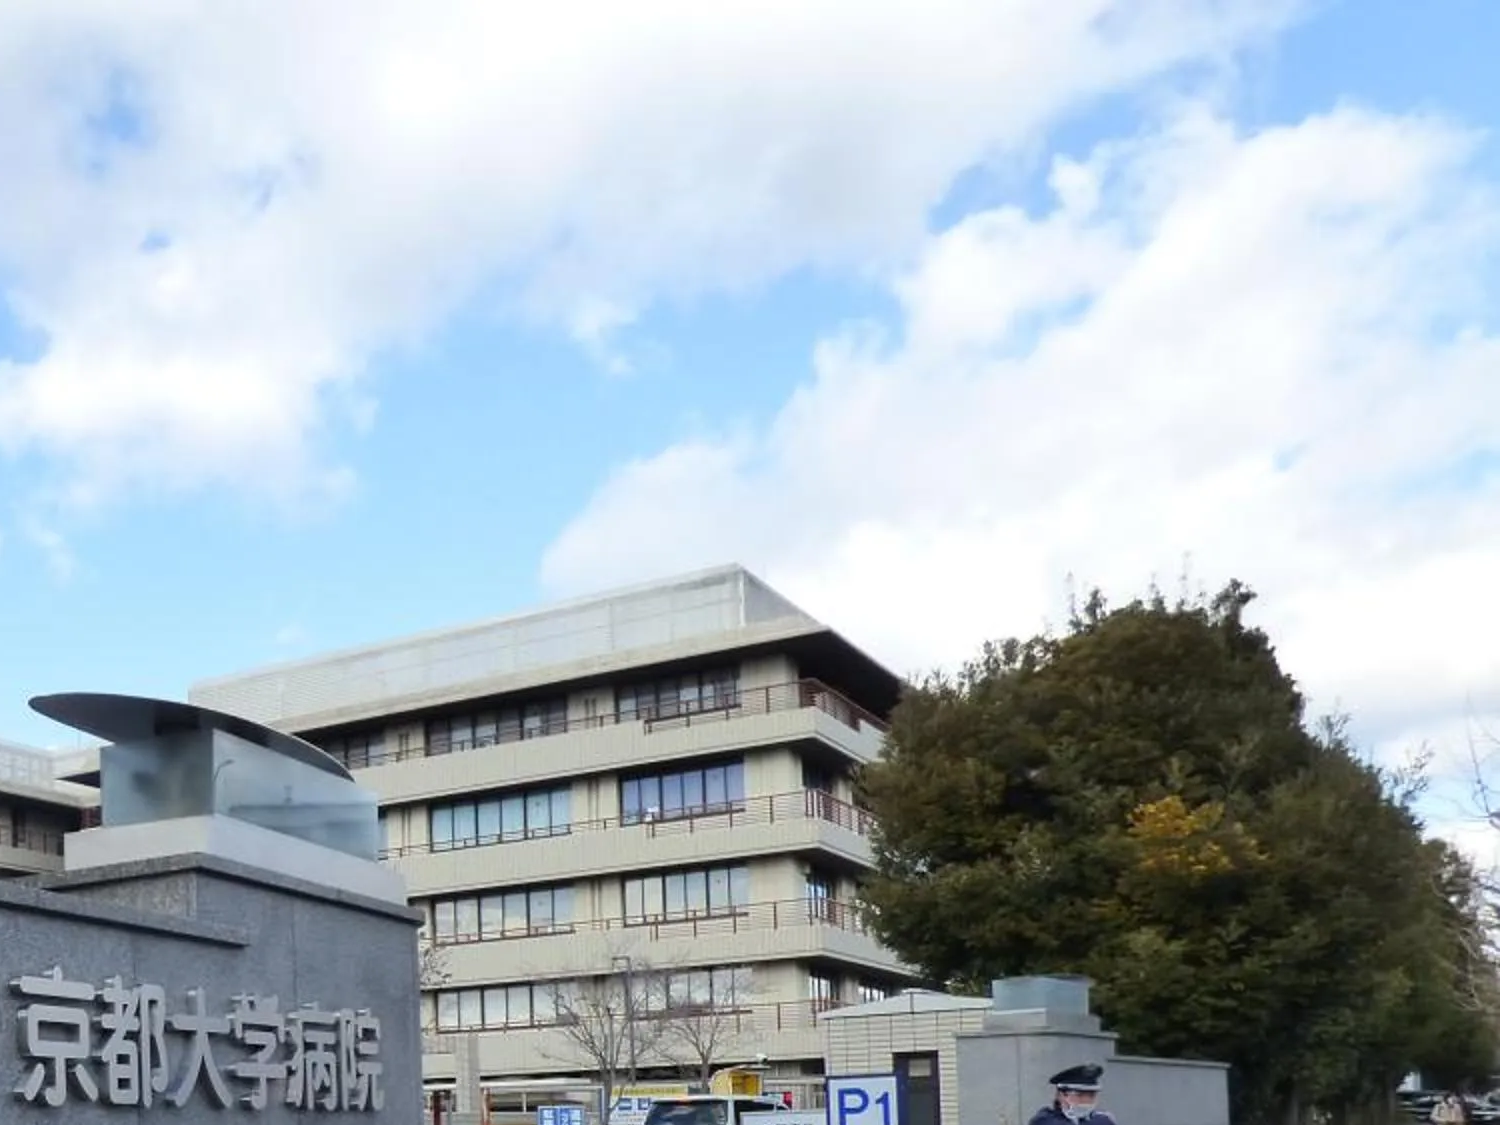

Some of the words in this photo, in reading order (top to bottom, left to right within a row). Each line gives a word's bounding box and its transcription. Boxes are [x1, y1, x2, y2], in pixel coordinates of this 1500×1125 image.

[12, 966, 385, 1111] 京都大学病院
